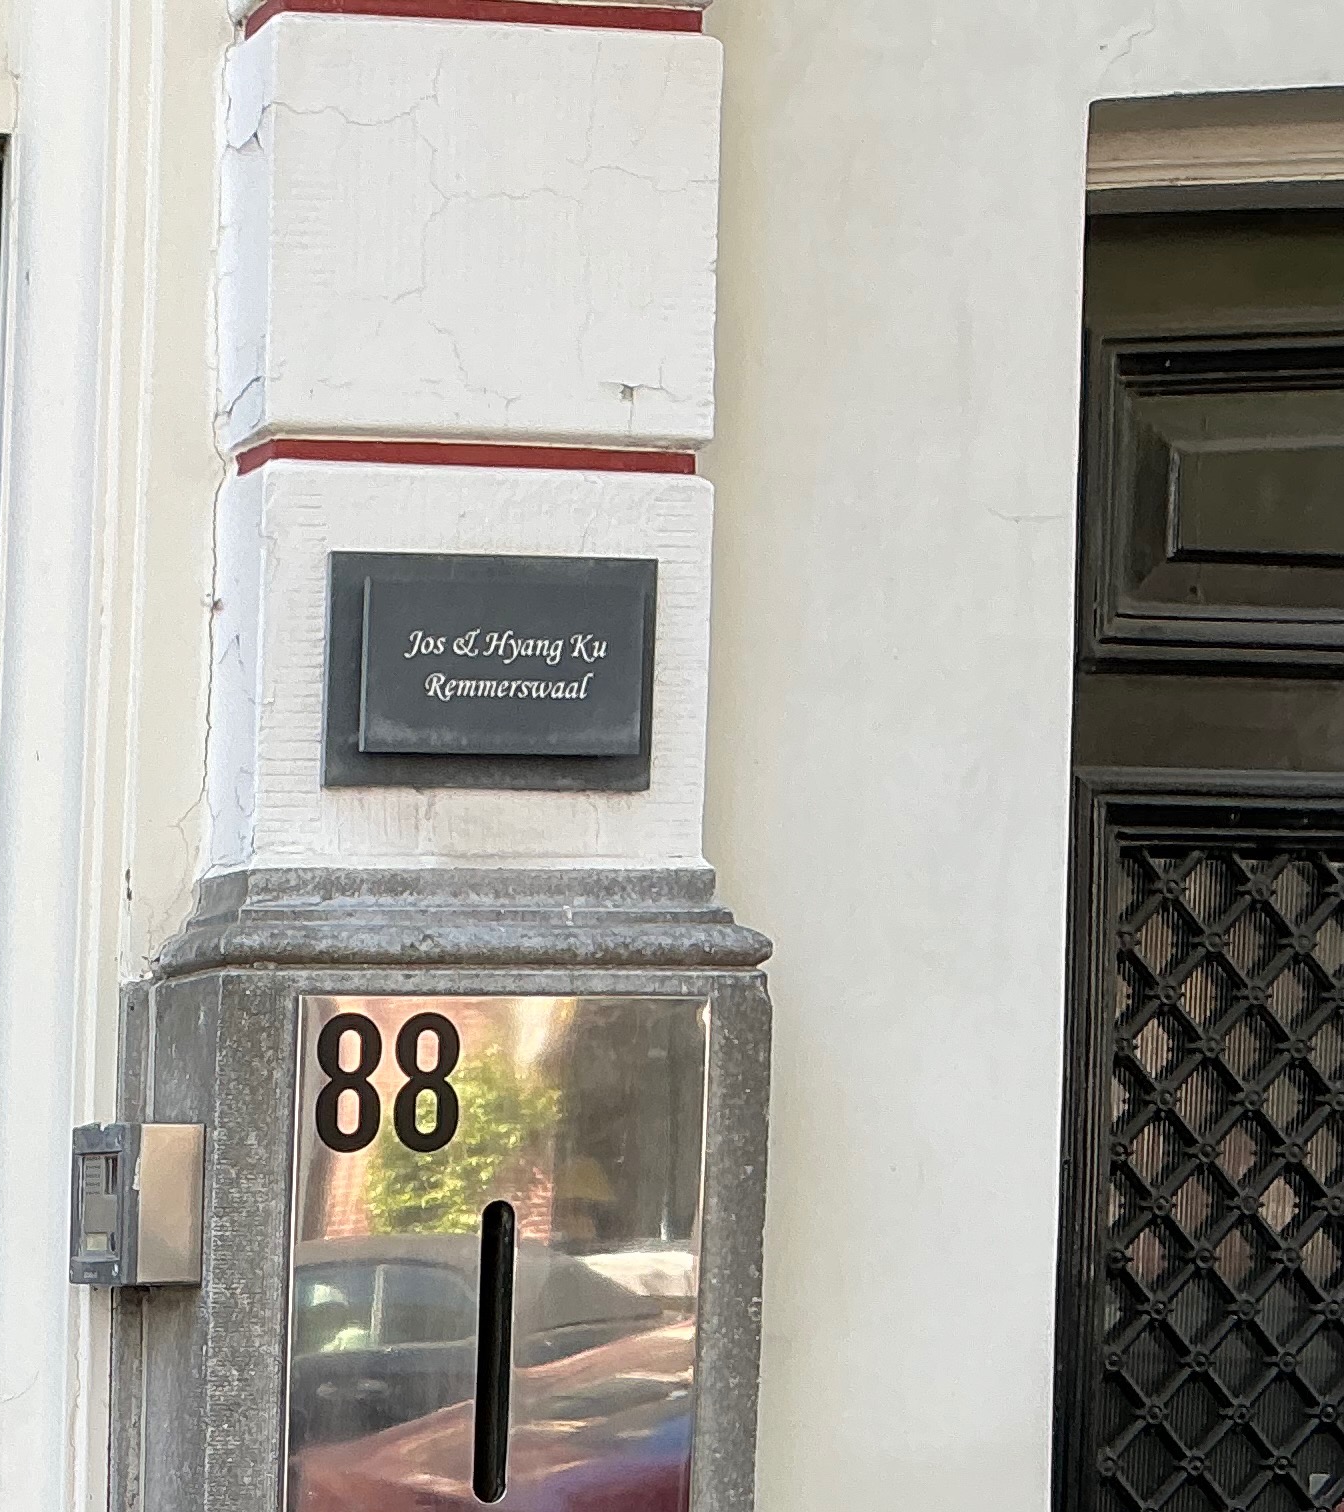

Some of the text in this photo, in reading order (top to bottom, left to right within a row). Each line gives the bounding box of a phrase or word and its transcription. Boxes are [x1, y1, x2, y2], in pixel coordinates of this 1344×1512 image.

[404, 628, 608, 665] Jos & Hyang Ku
[424, 672, 594, 701] Remmerswaal
[315, 1011, 461, 1153] 88
